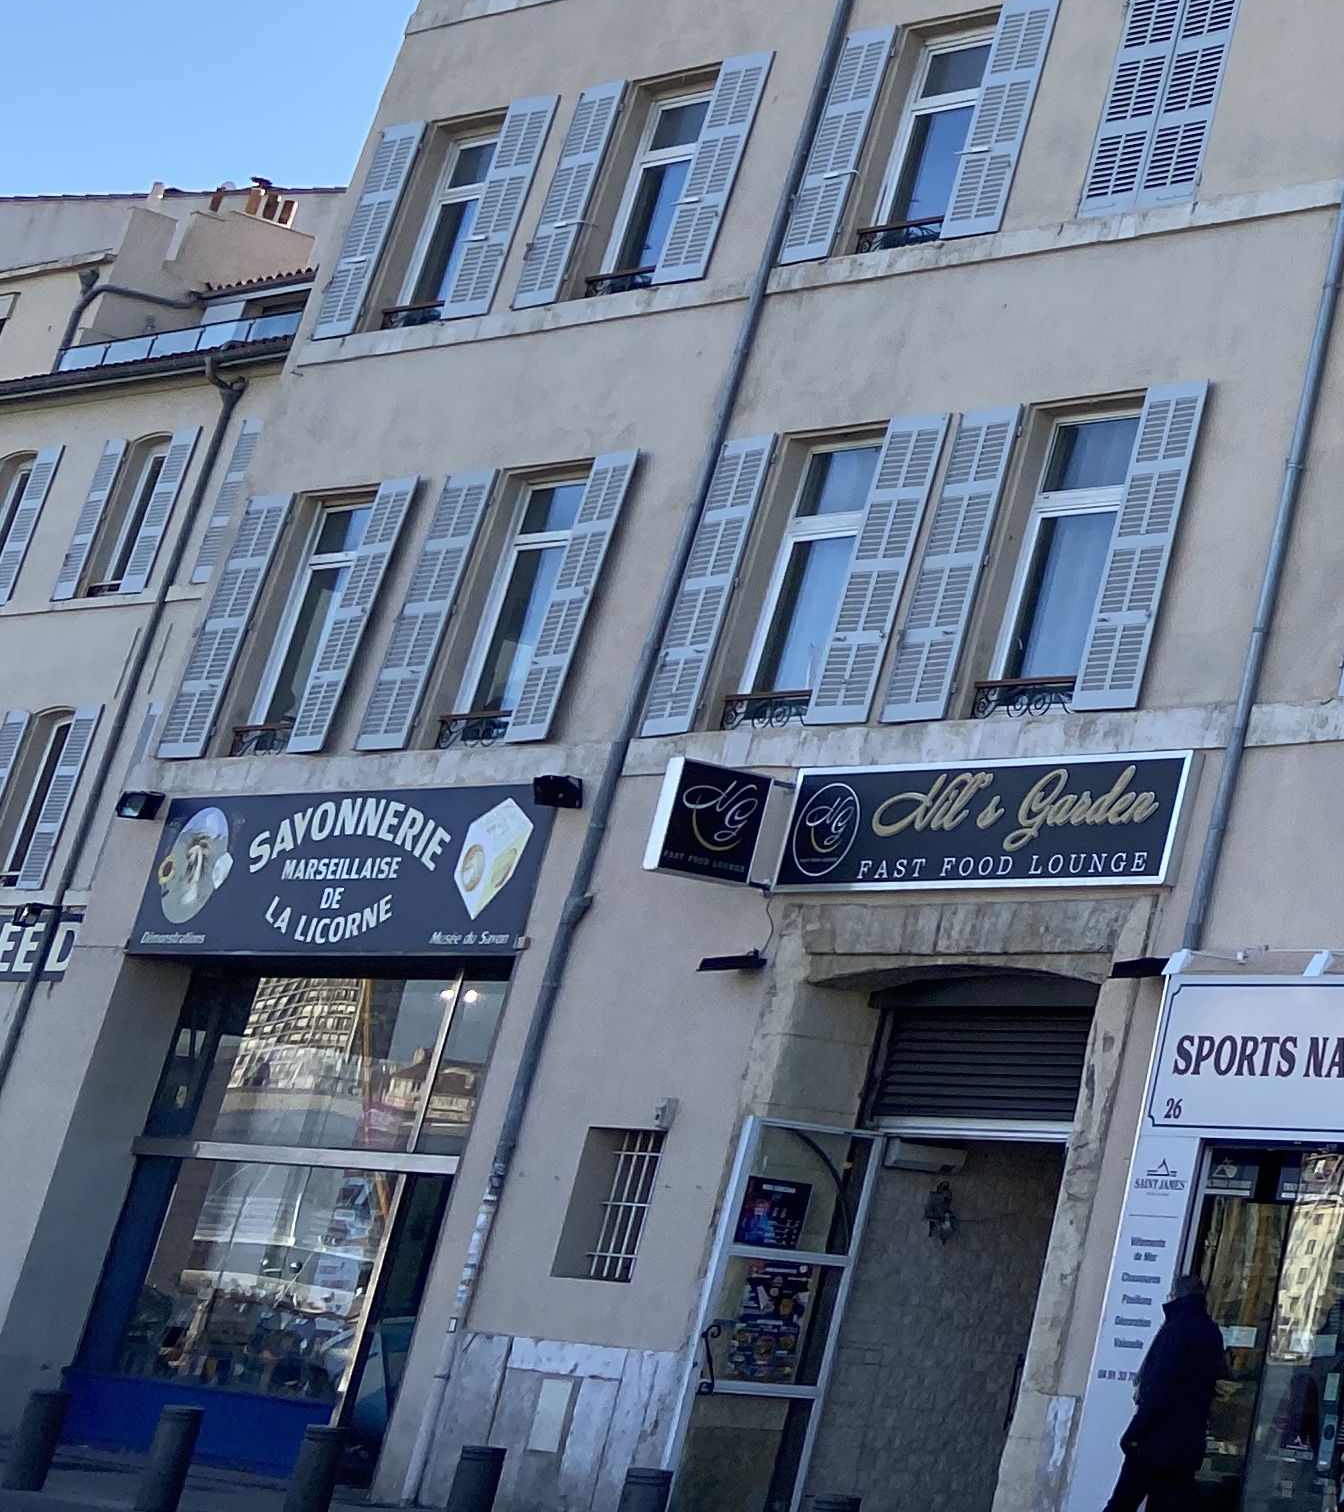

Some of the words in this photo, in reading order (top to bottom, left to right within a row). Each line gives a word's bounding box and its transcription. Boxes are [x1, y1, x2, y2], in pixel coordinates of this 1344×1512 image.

[1003, 764, 1160, 852] Garden
[248, 797, 451, 874] SAVONNERIE
[281, 856, 402, 881] MARSEILLAISE
[857, 858, 927, 880] FAST
[940, 855, 1014, 877] FOOD
[1028, 851, 1148, 875] LOUNGE
[319, 887, 345, 911] DE
[264, 895, 288, 935] LA
[294, 893, 394, 946] LICORNE
[463, 930, 478, 945] du
[478, 930, 510, 945] Savon
[1172, 1035, 1298, 1078] SPORTS
[1163, 1097, 1183, 1120] 26
[1133, 1177, 1159, 1190] SAINT
[1158, 1178, 1186, 1191] JAMES
